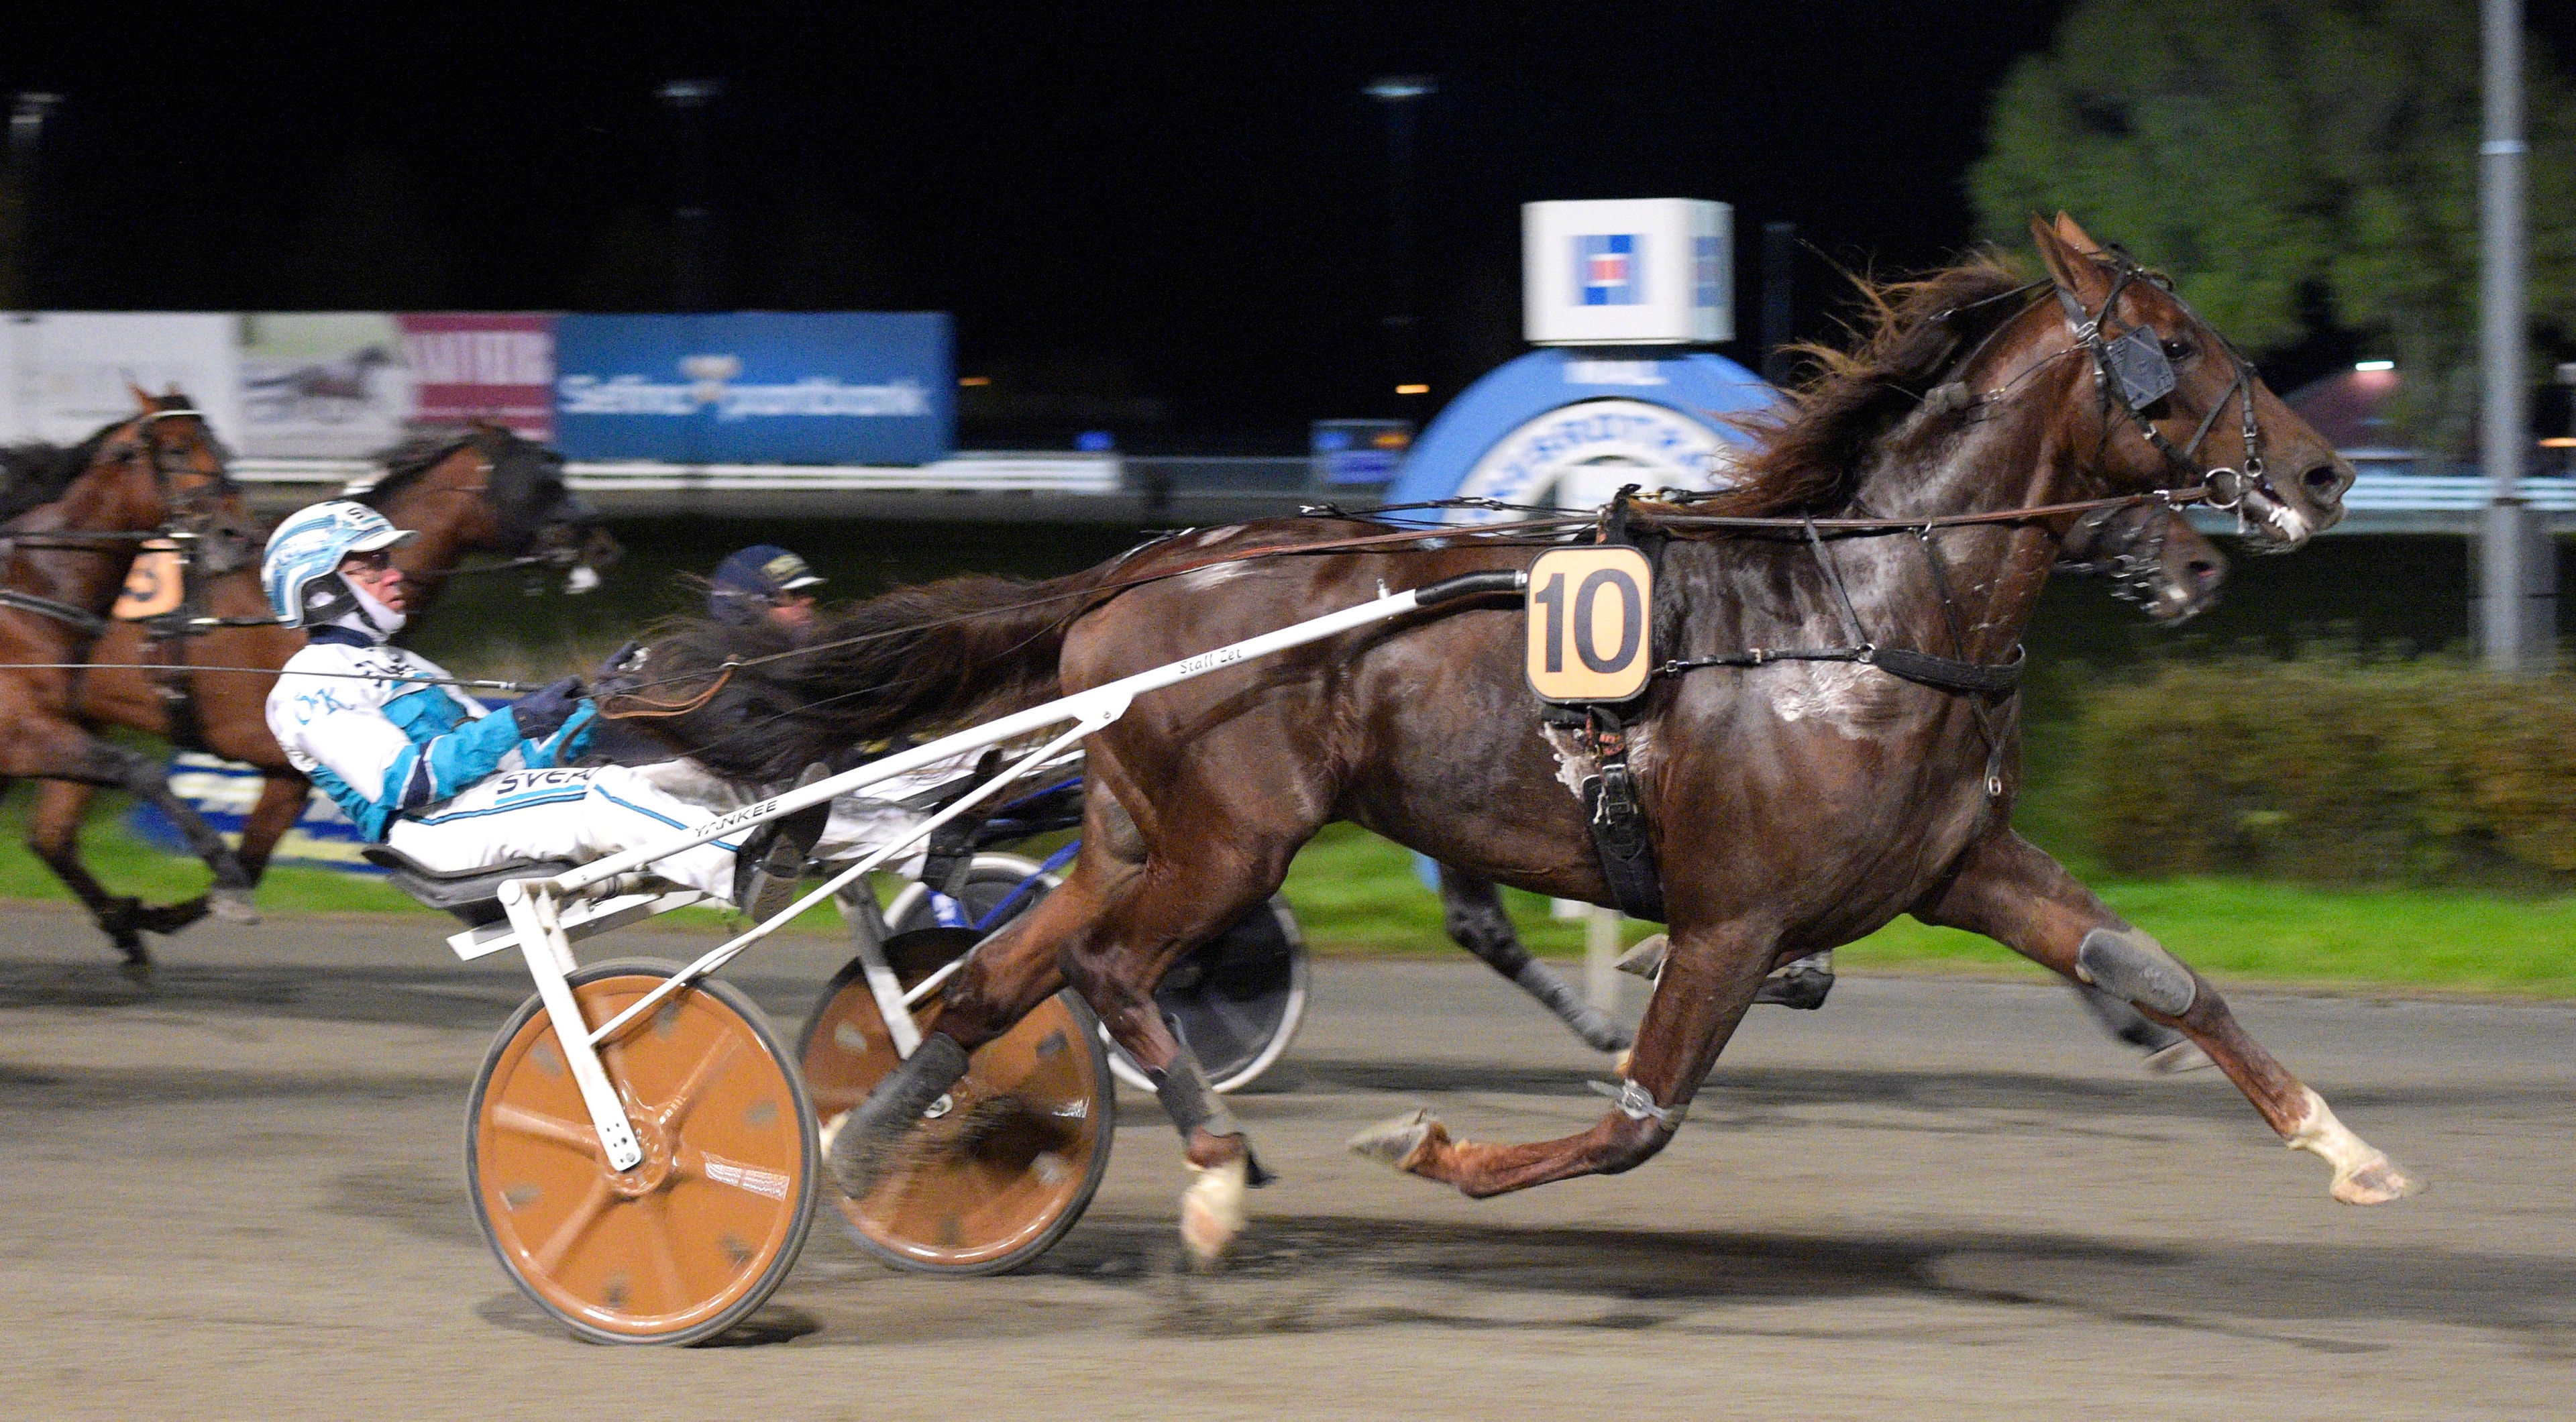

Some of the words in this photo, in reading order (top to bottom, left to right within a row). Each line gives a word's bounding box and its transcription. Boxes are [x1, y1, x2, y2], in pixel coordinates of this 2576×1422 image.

[1534, 568, 1642, 673] 10
[496, 769, 592, 795] SVEA
[695, 800, 778, 837] YANKEE
